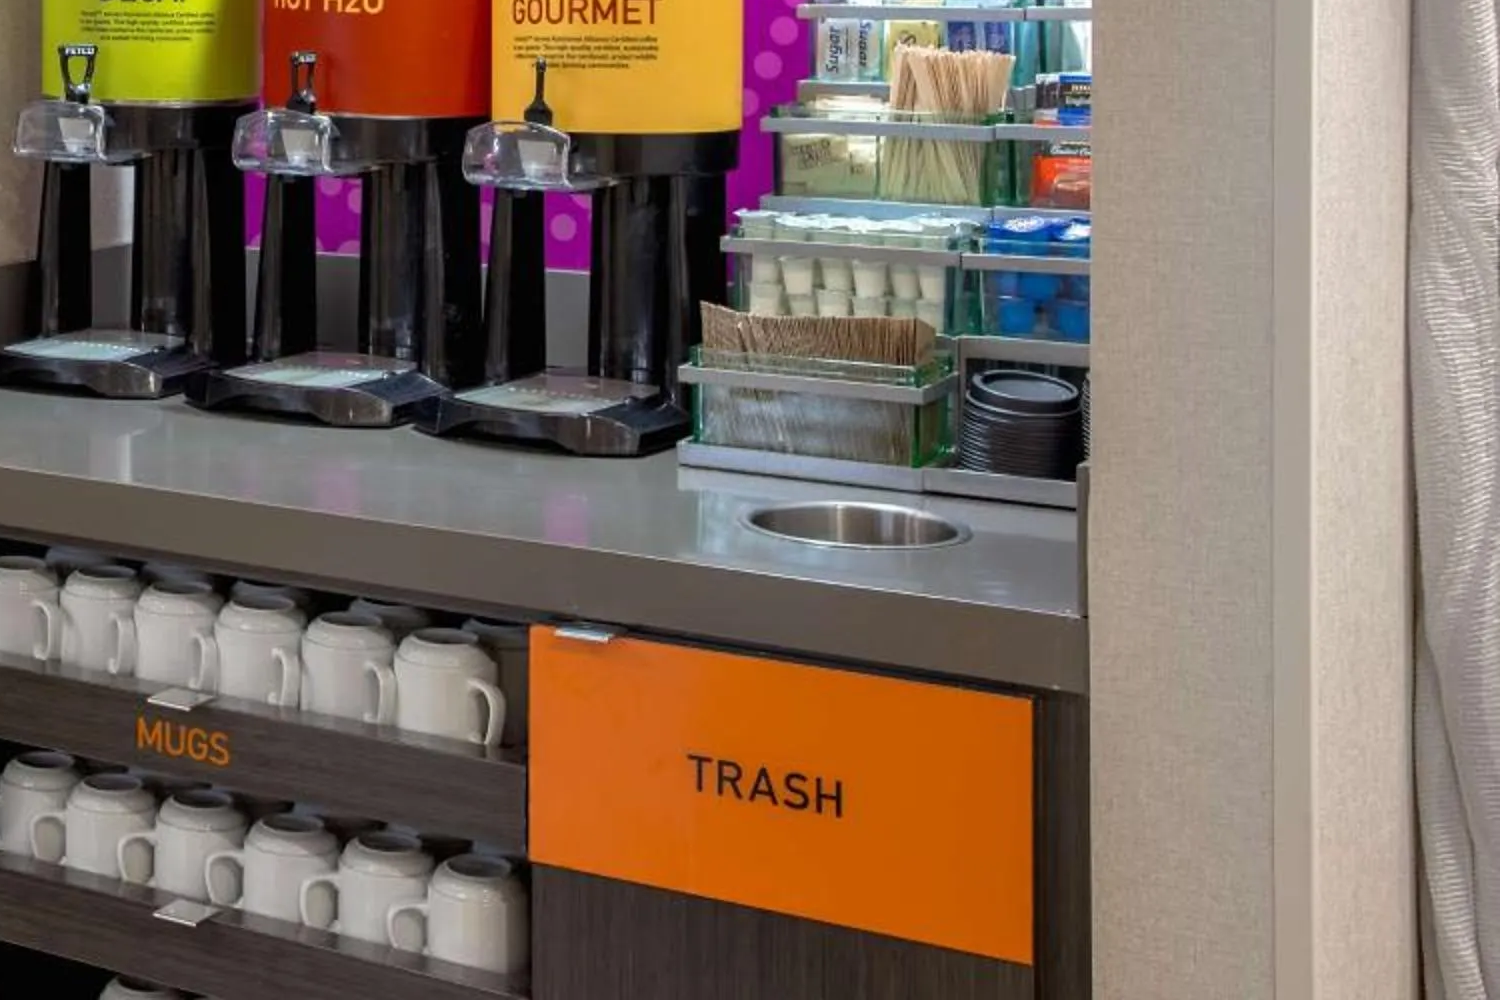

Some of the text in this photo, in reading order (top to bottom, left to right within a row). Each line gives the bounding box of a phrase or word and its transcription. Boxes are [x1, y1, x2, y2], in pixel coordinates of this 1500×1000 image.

[825, 26, 843, 74] Sugar
[136, 716, 231, 767] MUGS
[687, 754, 843, 818] TRASH
